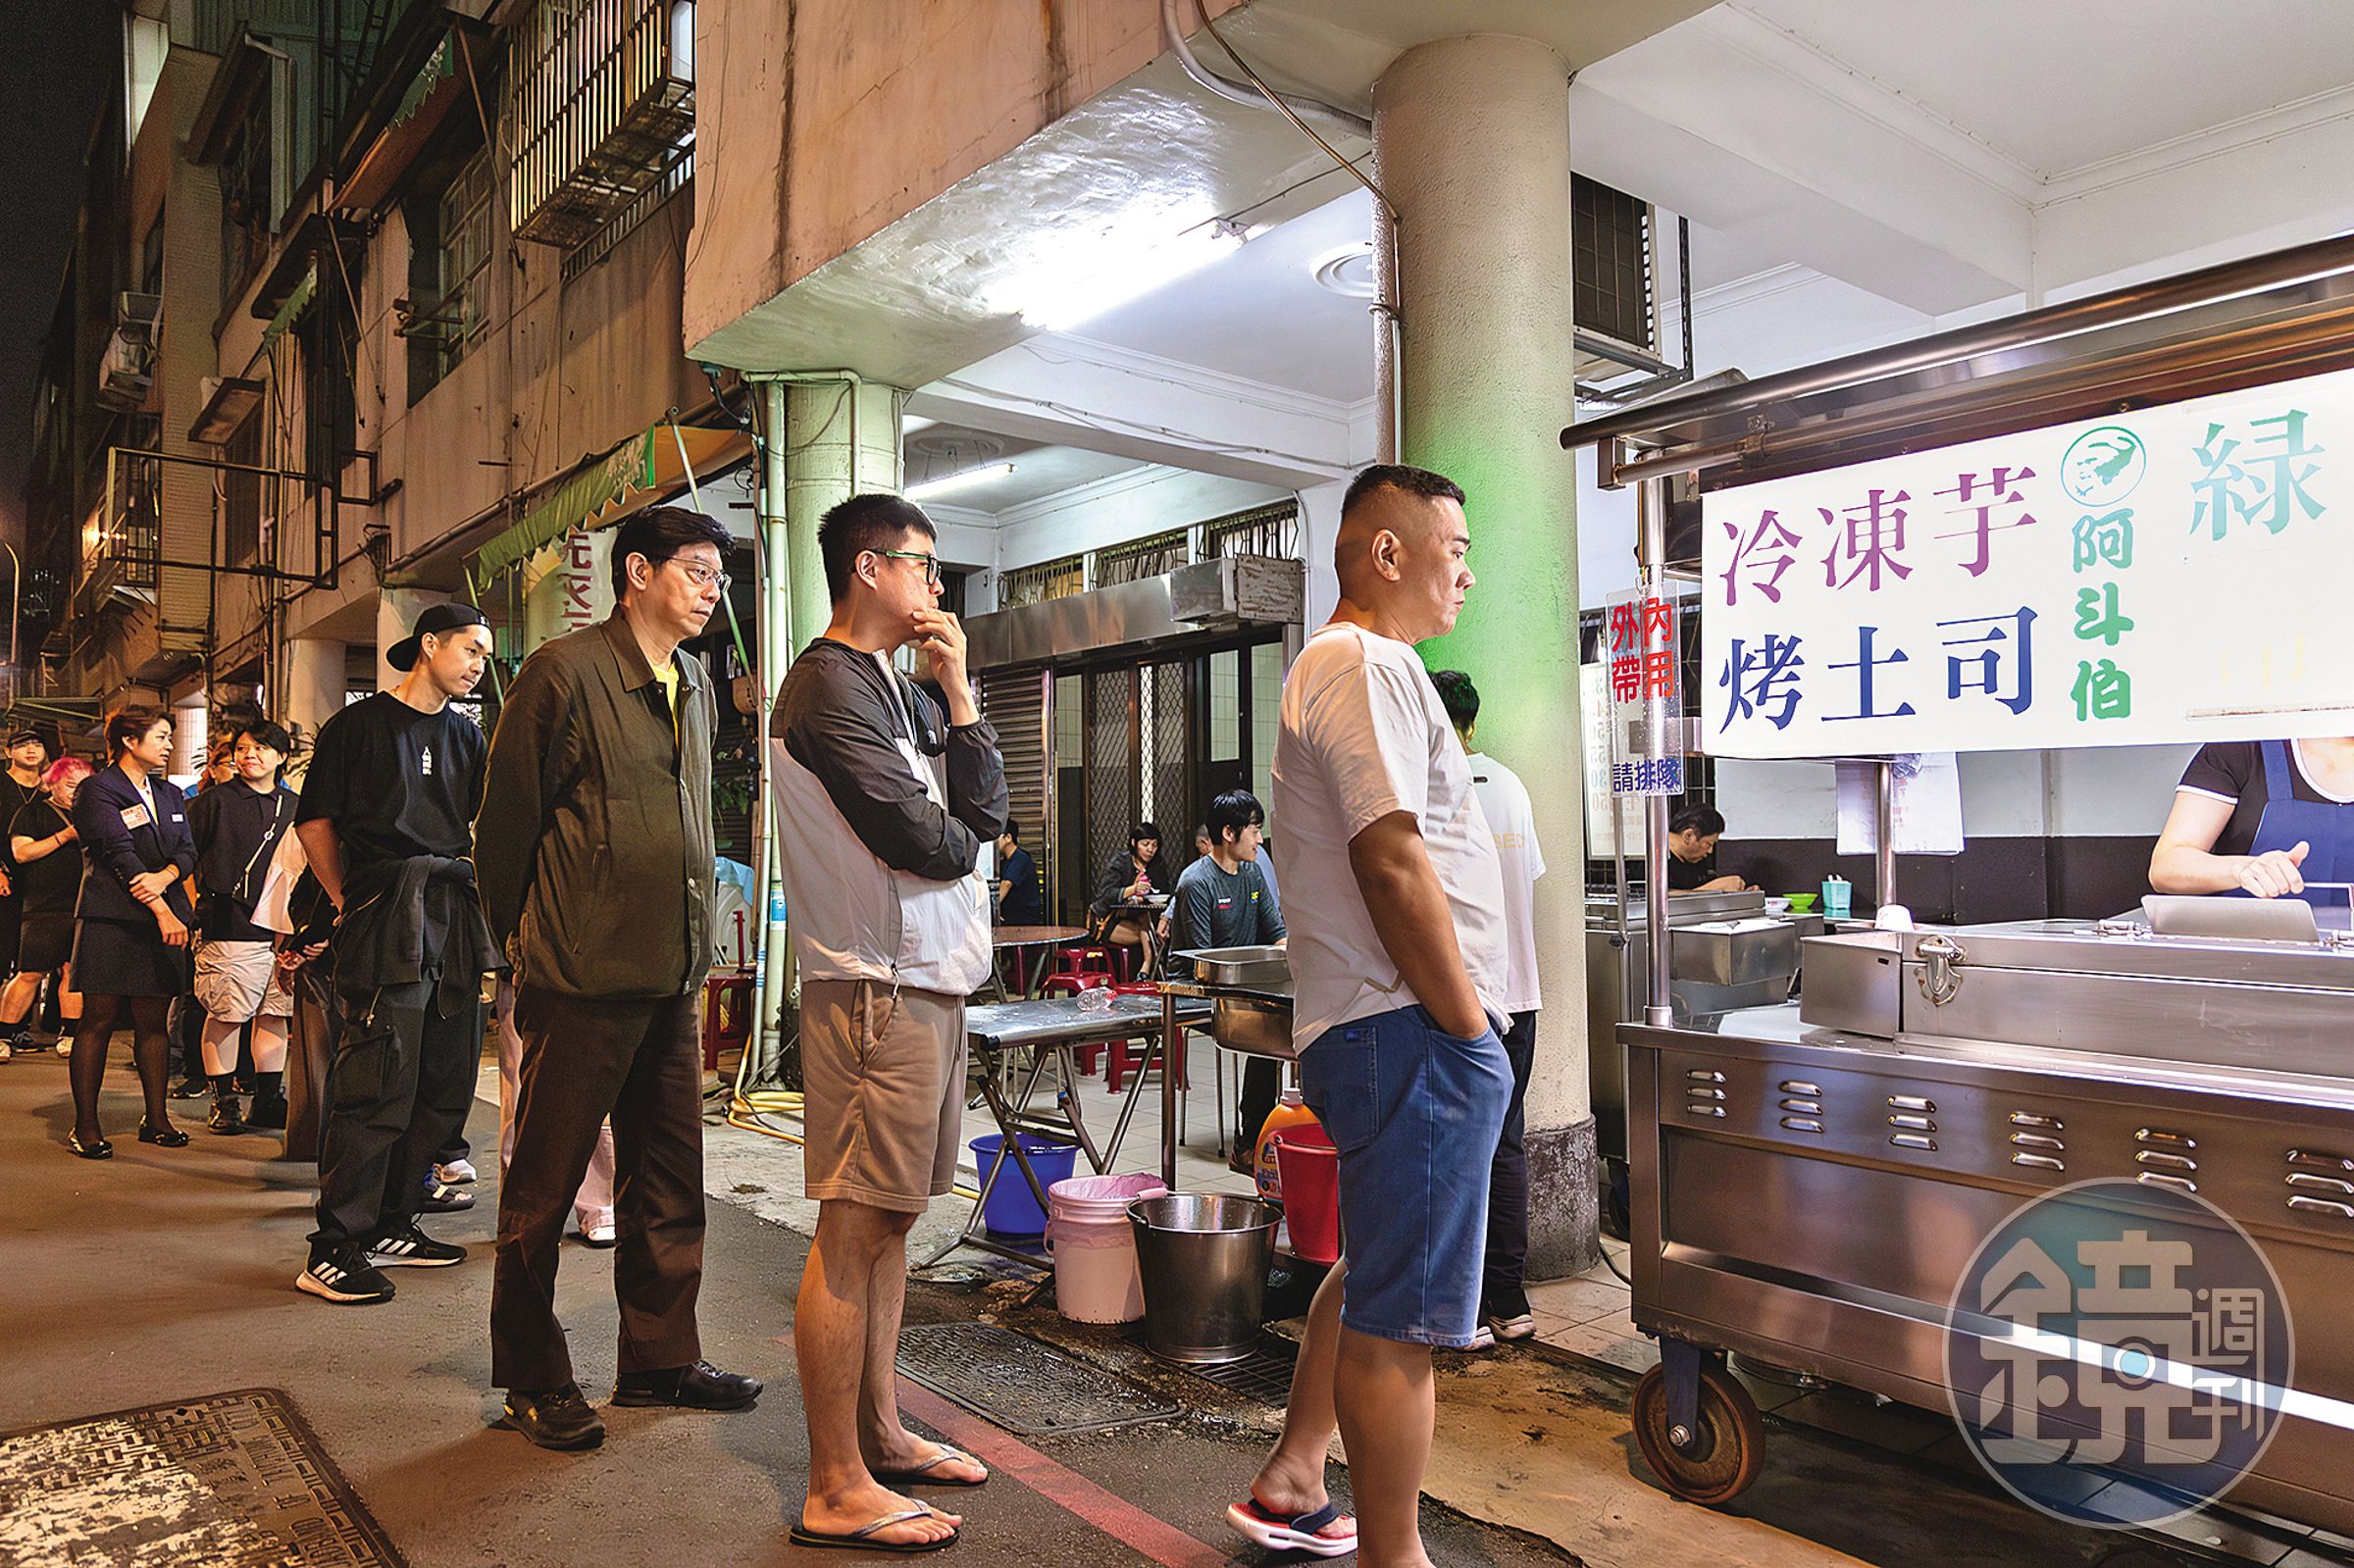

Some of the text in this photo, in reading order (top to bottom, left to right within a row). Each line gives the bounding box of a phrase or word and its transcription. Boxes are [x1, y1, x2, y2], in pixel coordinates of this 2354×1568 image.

[1719, 466, 2037, 606] 冷凍芋
[1719, 605, 2038, 734] 烤土司
[2070, 507, 2135, 722] 阿斗伯
[1612, 757, 1680, 792] 請排隊
